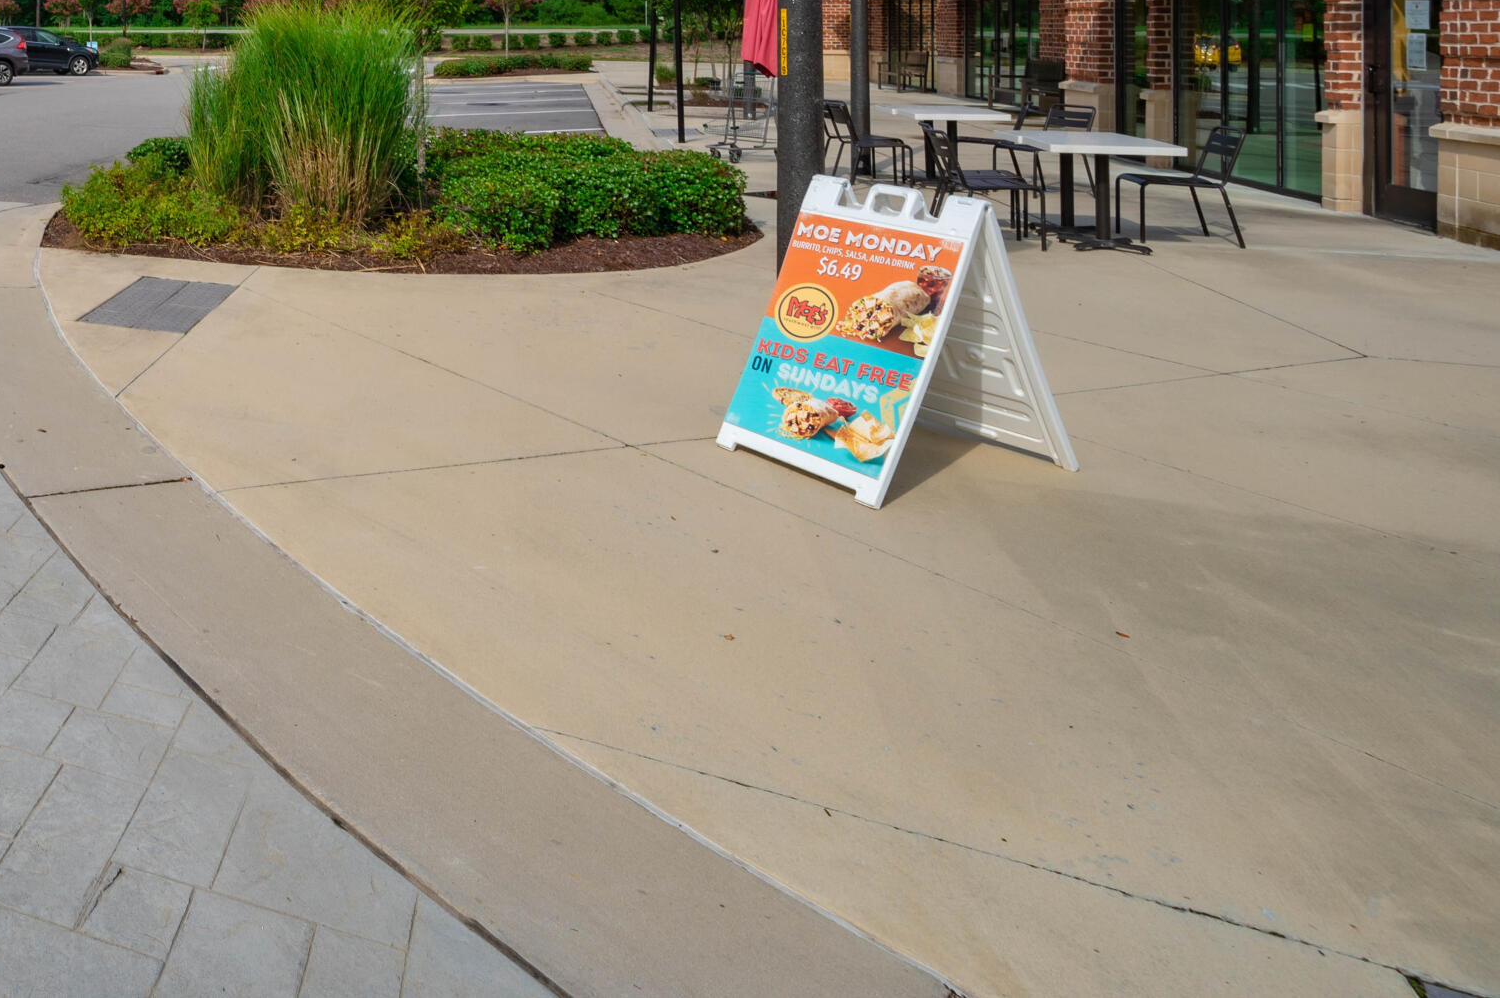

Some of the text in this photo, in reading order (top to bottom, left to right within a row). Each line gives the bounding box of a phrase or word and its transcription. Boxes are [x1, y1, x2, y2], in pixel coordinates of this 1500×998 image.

[792, 239, 916, 270] BURRITO, CHIPS, SALSA, AND A DRINK
[796, 221, 942, 262] MOE MONDAY
[816, 256, 862, 281] $6.49
[751, 355, 879, 404] ON SUNDAYS
[757, 338, 914, 391] KIDS EAT FREE
